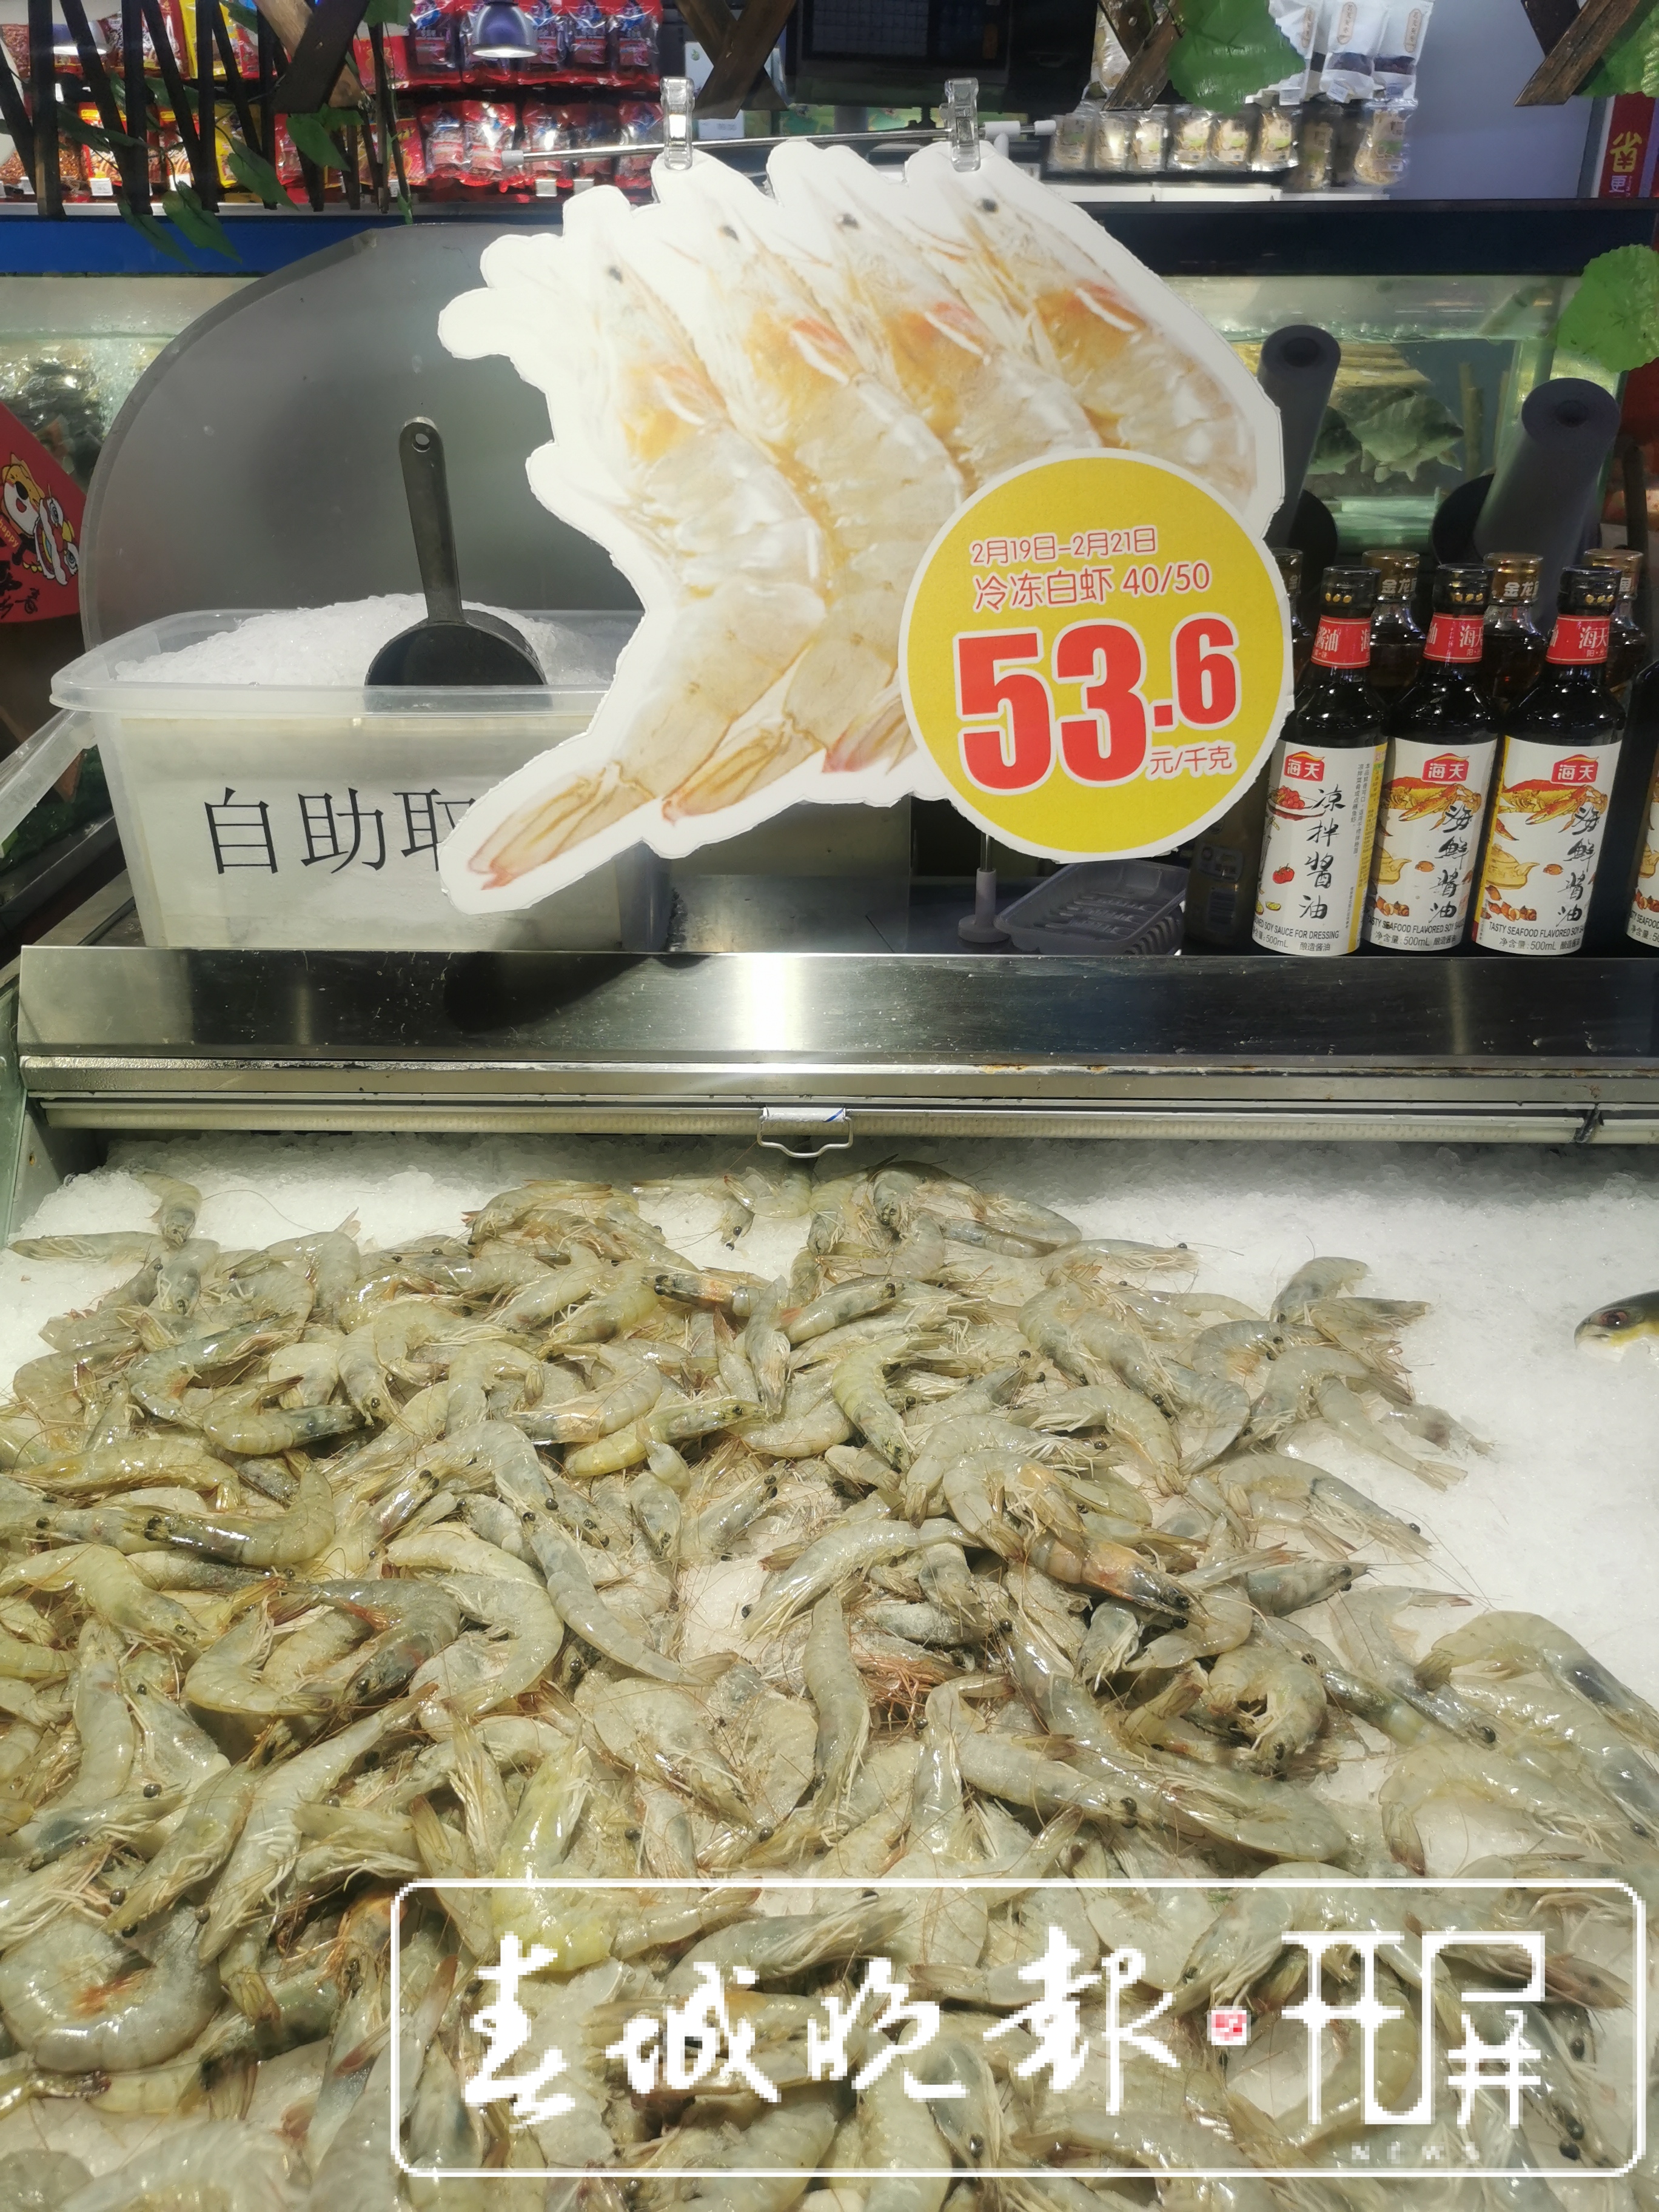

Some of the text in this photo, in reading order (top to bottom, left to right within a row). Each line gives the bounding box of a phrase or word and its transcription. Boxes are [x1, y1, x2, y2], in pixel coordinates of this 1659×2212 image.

[1610, 131, 1642, 172] 省
[971, 528, 1155, 565] 2月19日-2月21日
[975, 563, 1210, 611] 冷冻白虾 40/50
[1504, 581, 1539, 598] 金龙
[1578, 626, 1607, 649] 海天
[958, 618, 1236, 790] 53.6
[1150, 745, 1232, 776] 元/千克
[1287, 758, 1321, 780] 海天
[1428, 762, 1465, 780] 海天
[1557, 764, 1595, 781] 海天
[1298, 783, 1346, 920] 凉拌酱油
[1264, 921, 1274, 933] SOY
[1274, 925, 1294, 937] SAUCE
[1295, 929, 1307, 939] FOR
[1309, 930, 1339, 940] DRESSING
[1382, 920, 1412, 933] SEAFOOD
[1412, 924, 1444, 934] FLAVORED
[1489, 921, 1507, 934] TASTY
[1507, 926, 1538, 937] SEAFOOD
[1540, 928, 1570, 939] FLAVORED
[1299, 942, 1330, 952] 酿造酱油
